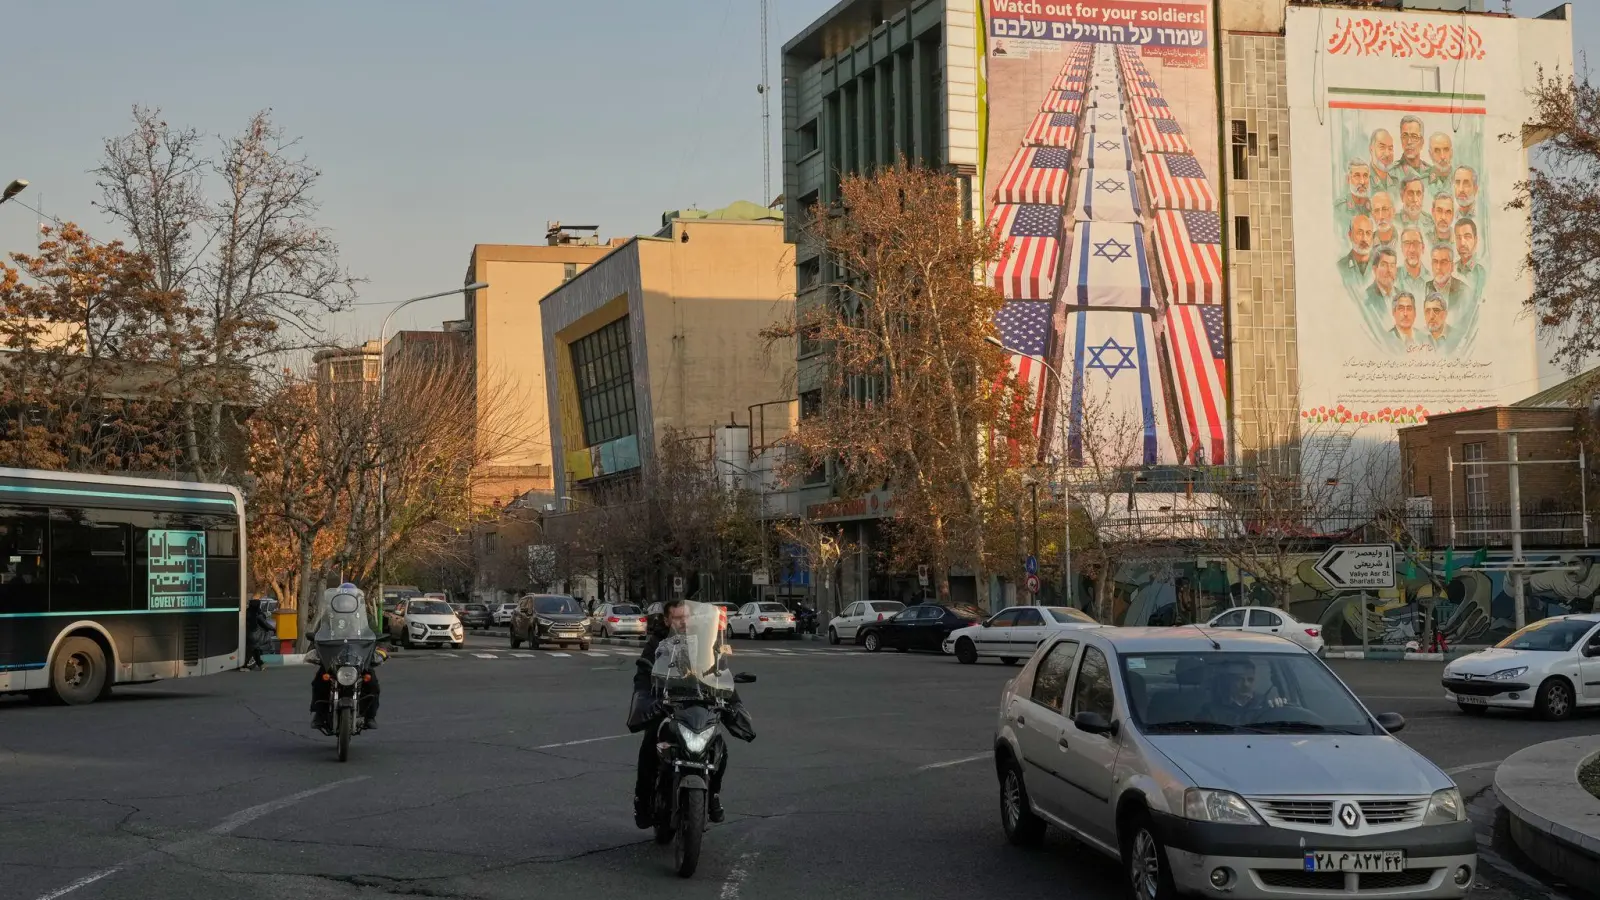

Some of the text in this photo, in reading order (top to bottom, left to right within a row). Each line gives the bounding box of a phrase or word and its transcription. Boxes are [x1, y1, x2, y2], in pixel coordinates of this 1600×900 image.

[994, 0, 1205, 24] Watch out for your soldiers!
[993, 17, 1204, 46] שמרו על החיילים שלכם
[1354, 560, 1383, 570] شریعتی
[151, 596, 203, 607] LOVELY TEHRAN
